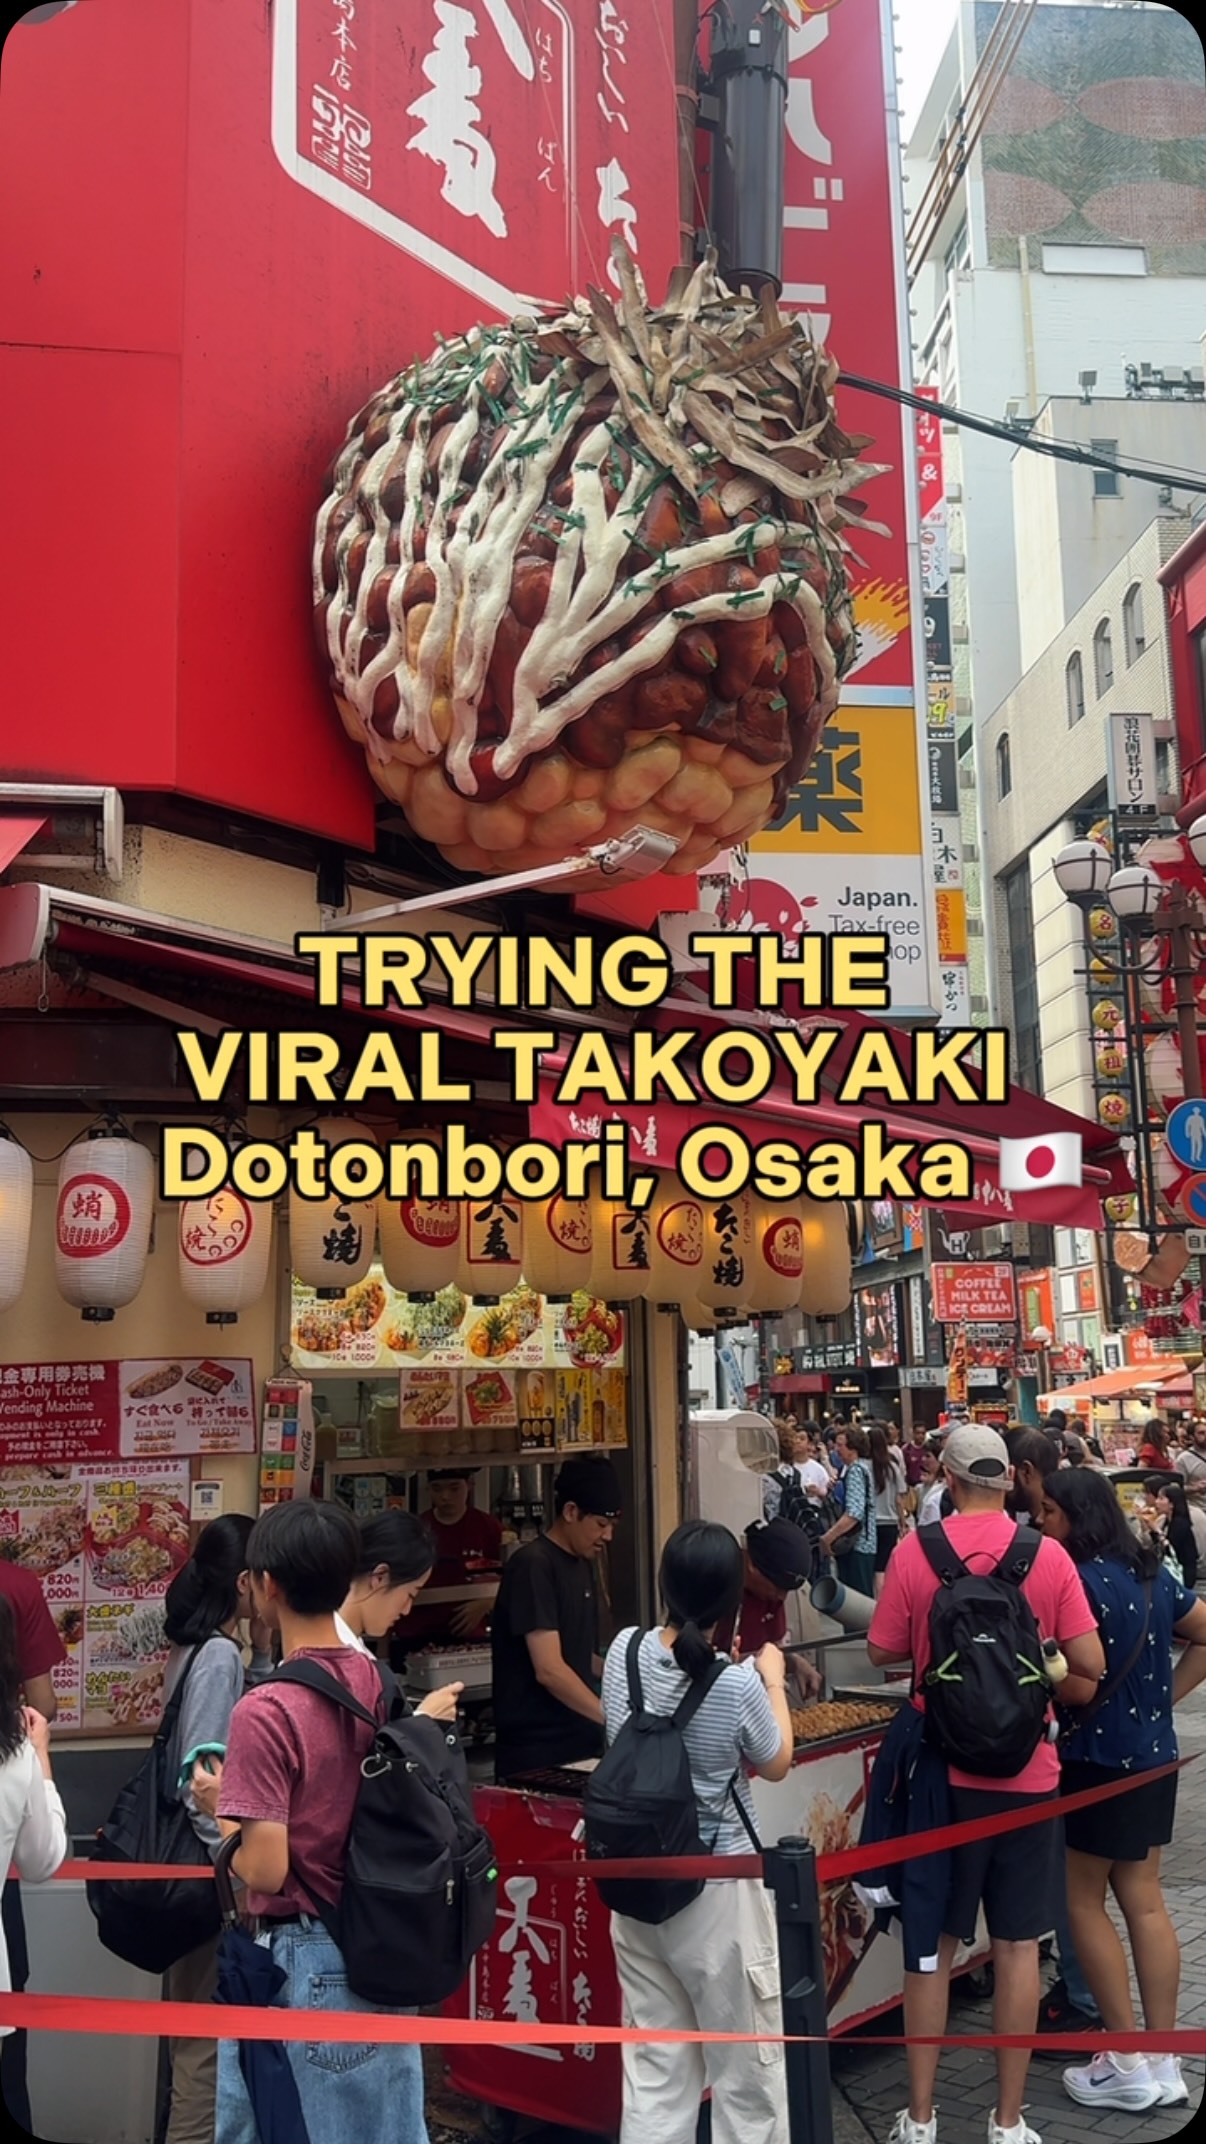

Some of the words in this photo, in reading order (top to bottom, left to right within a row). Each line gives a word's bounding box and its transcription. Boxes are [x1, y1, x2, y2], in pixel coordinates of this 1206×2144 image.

[837, 886, 918, 911] Japan.
[828, 914, 920, 936] Tax-free
[473, 1202, 519, 1263] 八番
[712, 1202, 745, 1288] たこ焼
[955, 1278, 1001, 1289] COFFEE
[951, 1290, 981, 1301] MILK
[983, 1290, 1008, 1301] TEA
[949, 1303, 969, 1314] ICE
[970, 1303, 1011, 1314] CREAM
[0, 1364, 106, 1384] 金専用券売機
[0, 1385, 52, 1401] ash-Only
[55, 1383, 90, 1397] Ticket
[46, 1399, 95, 1413] Machine
[124, 1402, 184, 1418] すぐ食べる
